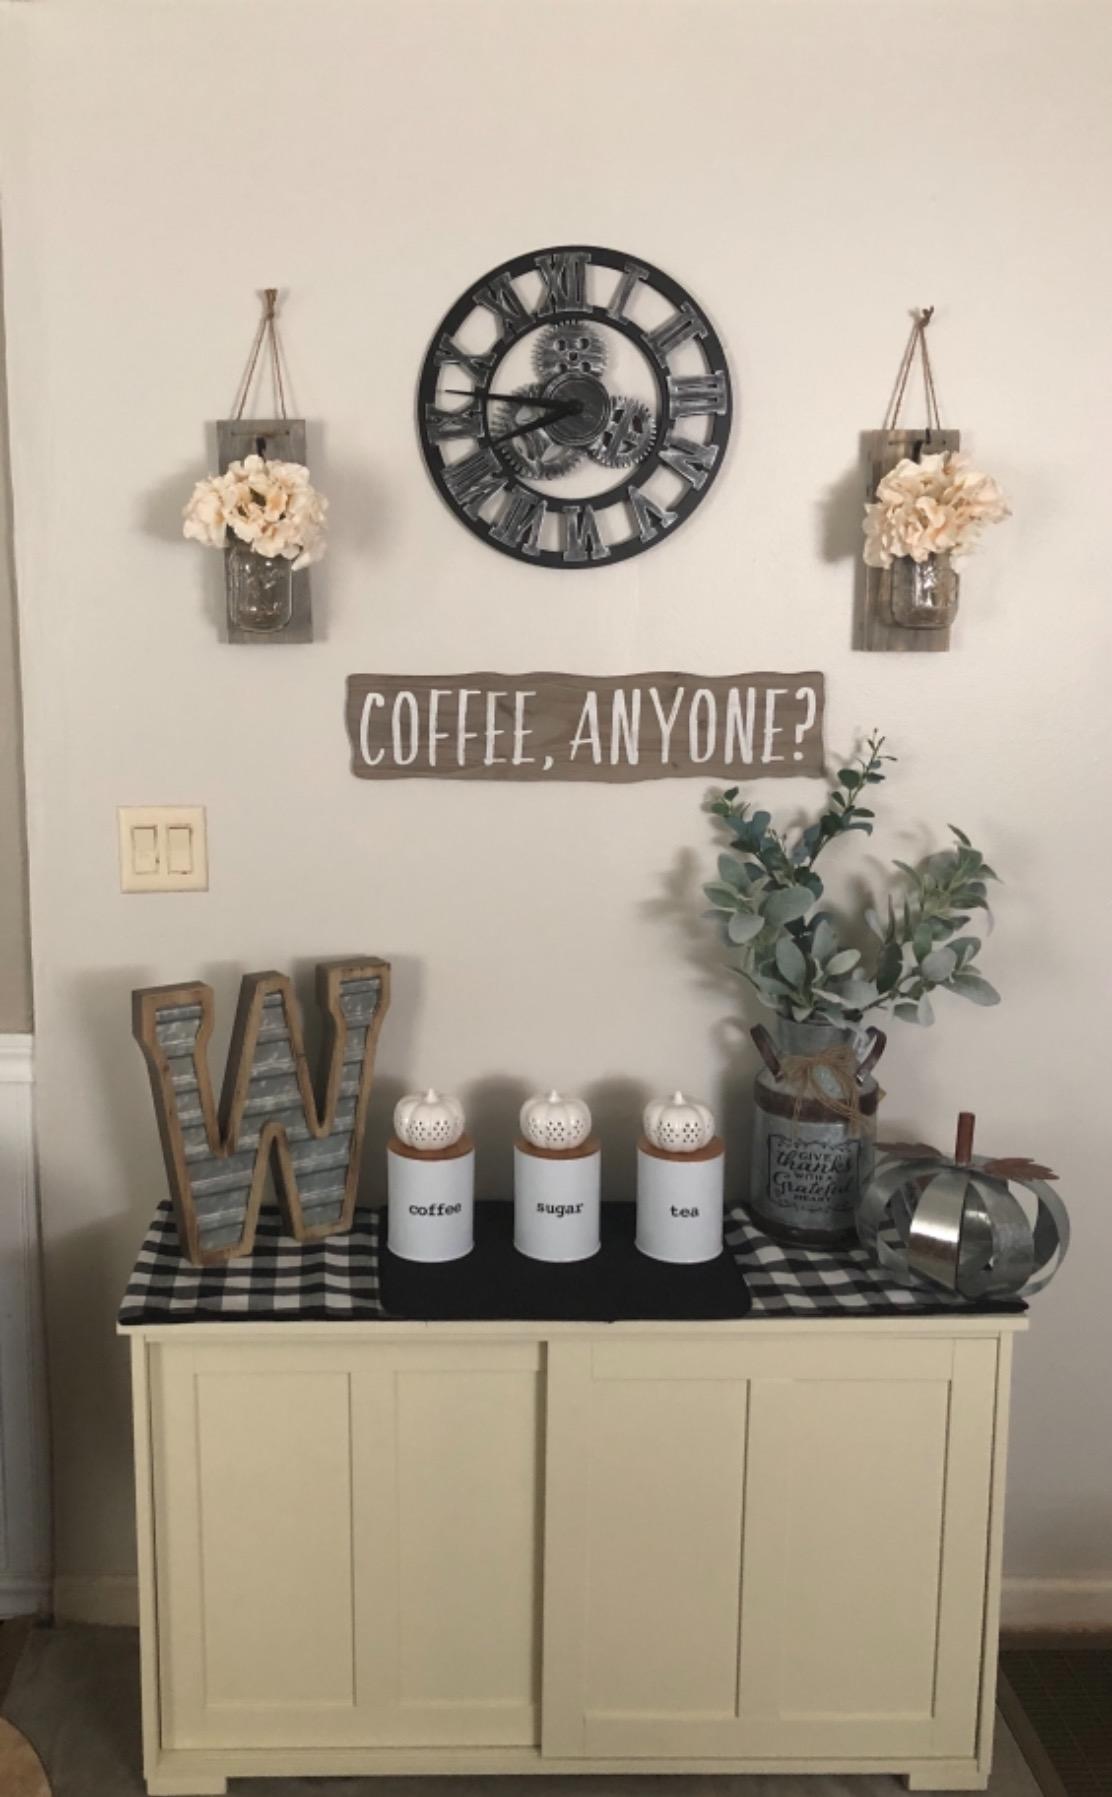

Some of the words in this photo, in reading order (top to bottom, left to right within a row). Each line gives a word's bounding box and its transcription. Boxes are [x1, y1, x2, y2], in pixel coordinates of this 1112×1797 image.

[360, 688, 554, 771] COFFEE,
[570, 687, 817, 767] ANYONE?
[132, 957, 390, 1265] W
[409, 1202, 462, 1216] coffee
[536, 1202, 584, 1218] sugar
[670, 1205, 700, 1218] tea
